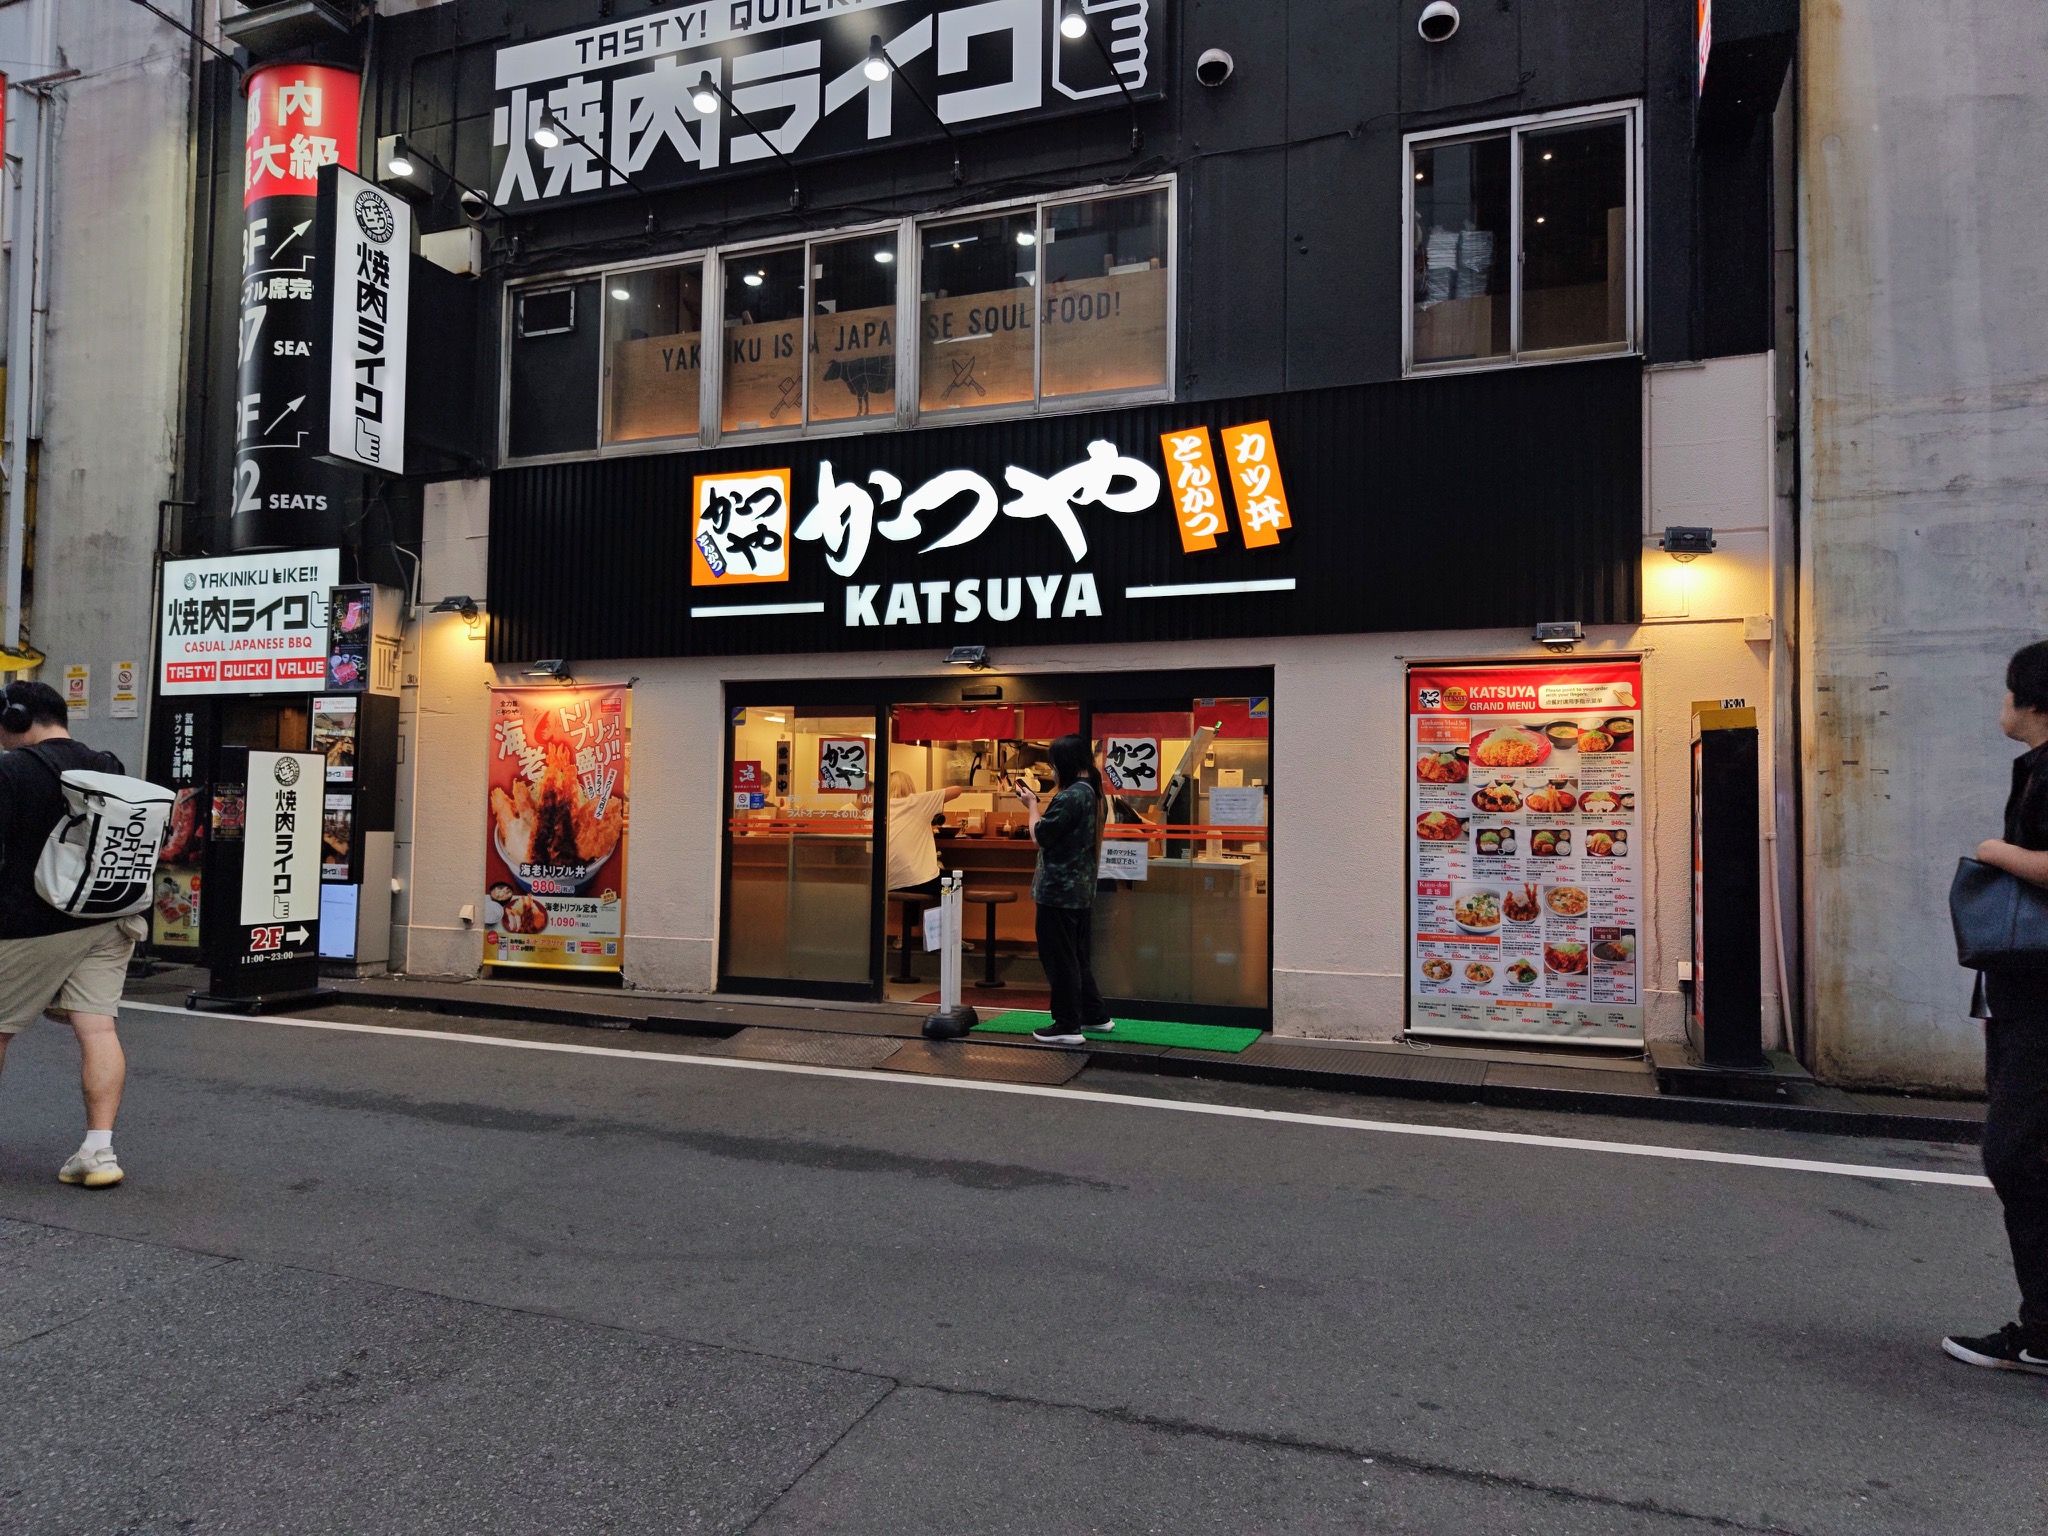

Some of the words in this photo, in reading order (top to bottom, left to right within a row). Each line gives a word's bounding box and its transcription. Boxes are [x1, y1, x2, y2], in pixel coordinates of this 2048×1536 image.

[575, 9, 706, 64] TASTY!
[238, 305, 267, 369] 7
[273, 340, 312, 356] SEA
[355, 242, 390, 424] 焼肉ライク
[774, 333, 793, 359] IS
[968, 303, 1031, 334] SOUL
[1047, 292, 1120, 324] FOOD!
[269, 494, 328, 511] SEATS
[1171, 435, 1221, 538] とんかつ
[1235, 432, 1285, 532] カツ丼
[794, 439, 1160, 577] かつや
[199, 570, 268, 588] YAKINIKU
[846, 573, 1103, 627] KATSUYA
[169, 595, 309, 636] 焼肉ライク
[185, 640, 225, 653] CASUAL
[229, 637, 284, 651] JAPANESE
[289, 636, 311, 649] BBQ
[169, 665, 214, 679] TASTY!
[224, 663, 268, 677] QUICK!
[279, 661, 324, 675] VALUE
[1470, 686, 1535, 698] KATSUYA
[1470, 702, 1504, 711] GRAND
[1507, 701, 1535, 710] MENU
[96, 826, 125, 879] FACE
[115, 807, 147, 879] NORTH
[131, 840, 156, 880] THE
[274, 789, 296, 894] 焼肉ライク
[521, 864, 586, 877] 海老トリプル丼
[545, 902, 598, 913] 海老トリプル定食
[251, 927, 283, 951] 2F
